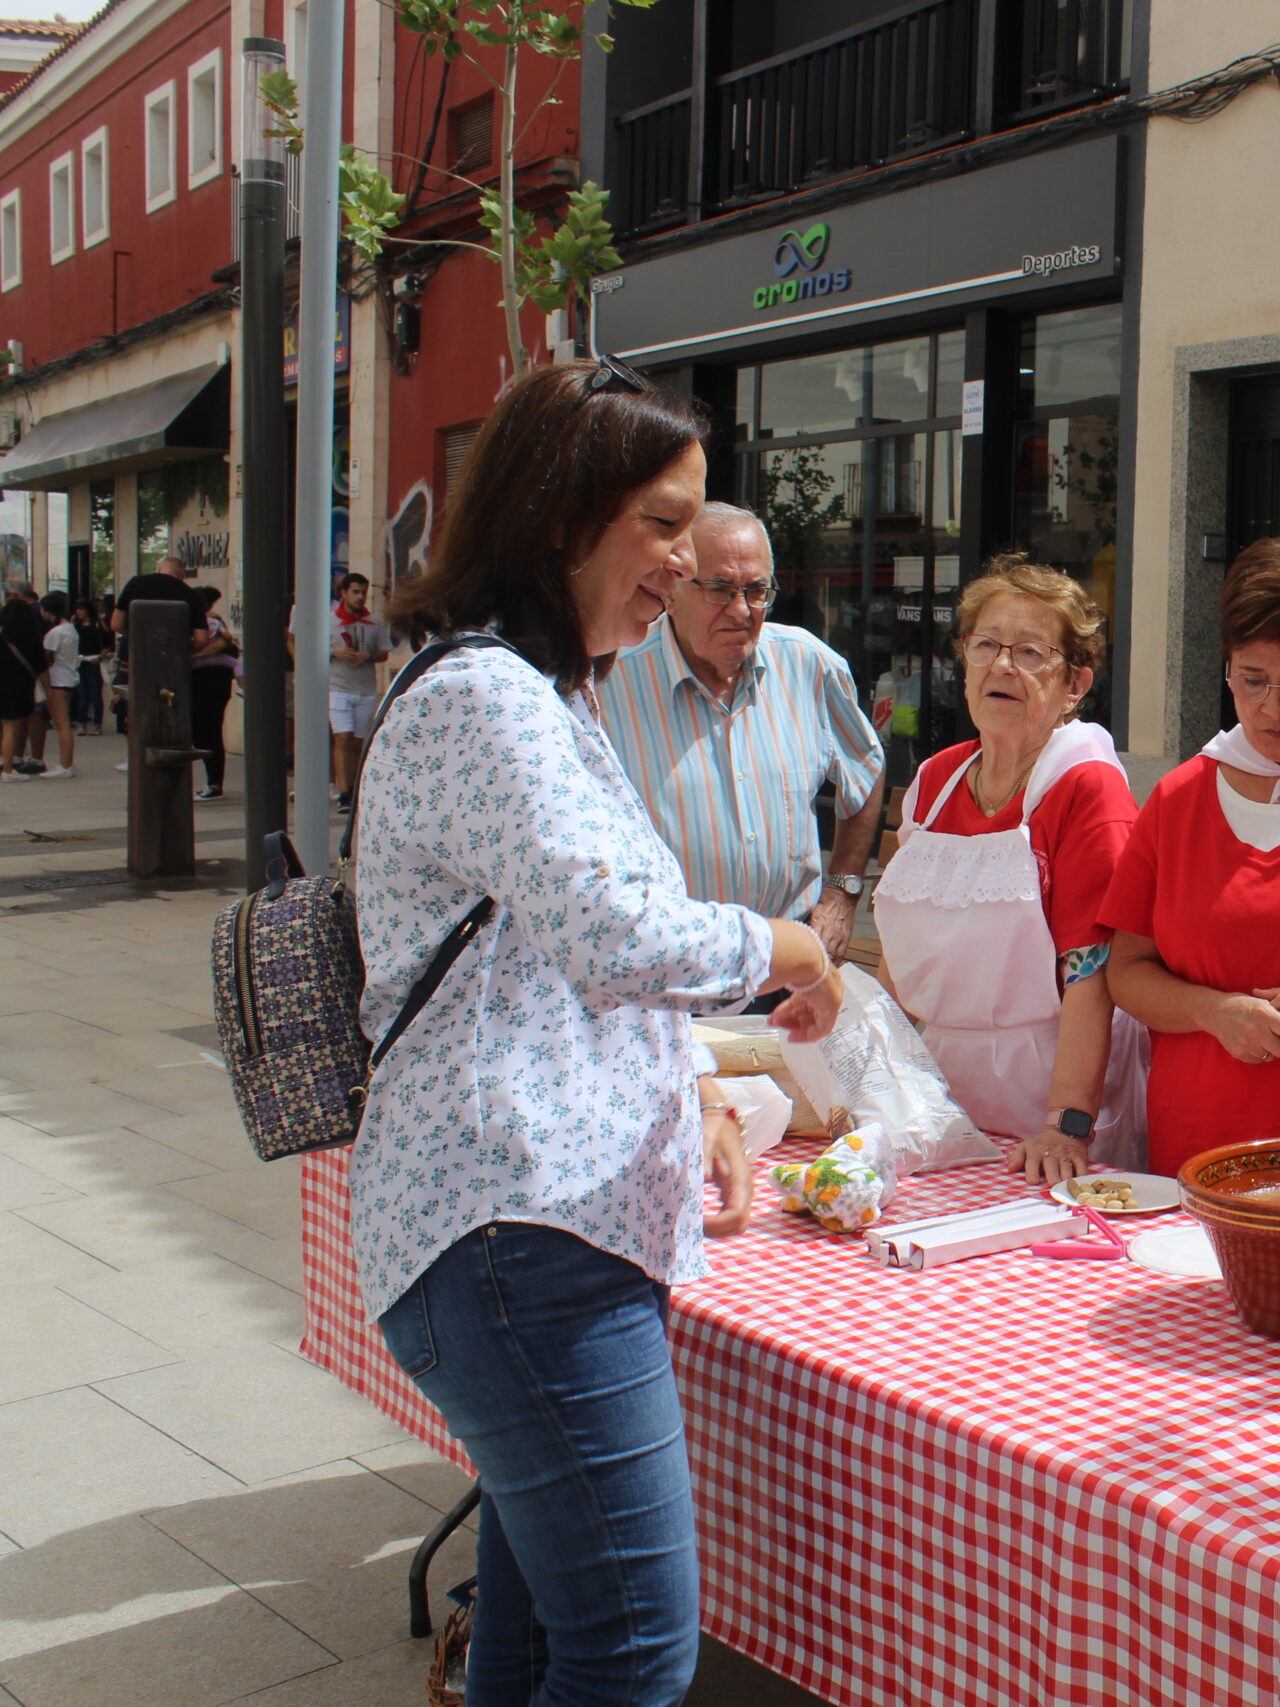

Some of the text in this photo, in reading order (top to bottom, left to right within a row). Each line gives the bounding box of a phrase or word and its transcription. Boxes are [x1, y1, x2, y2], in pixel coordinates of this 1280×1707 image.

[1022, 245, 1100, 277] Deportes
[753, 268, 853, 310] cronos
[897, 605, 922, 622] VANS
